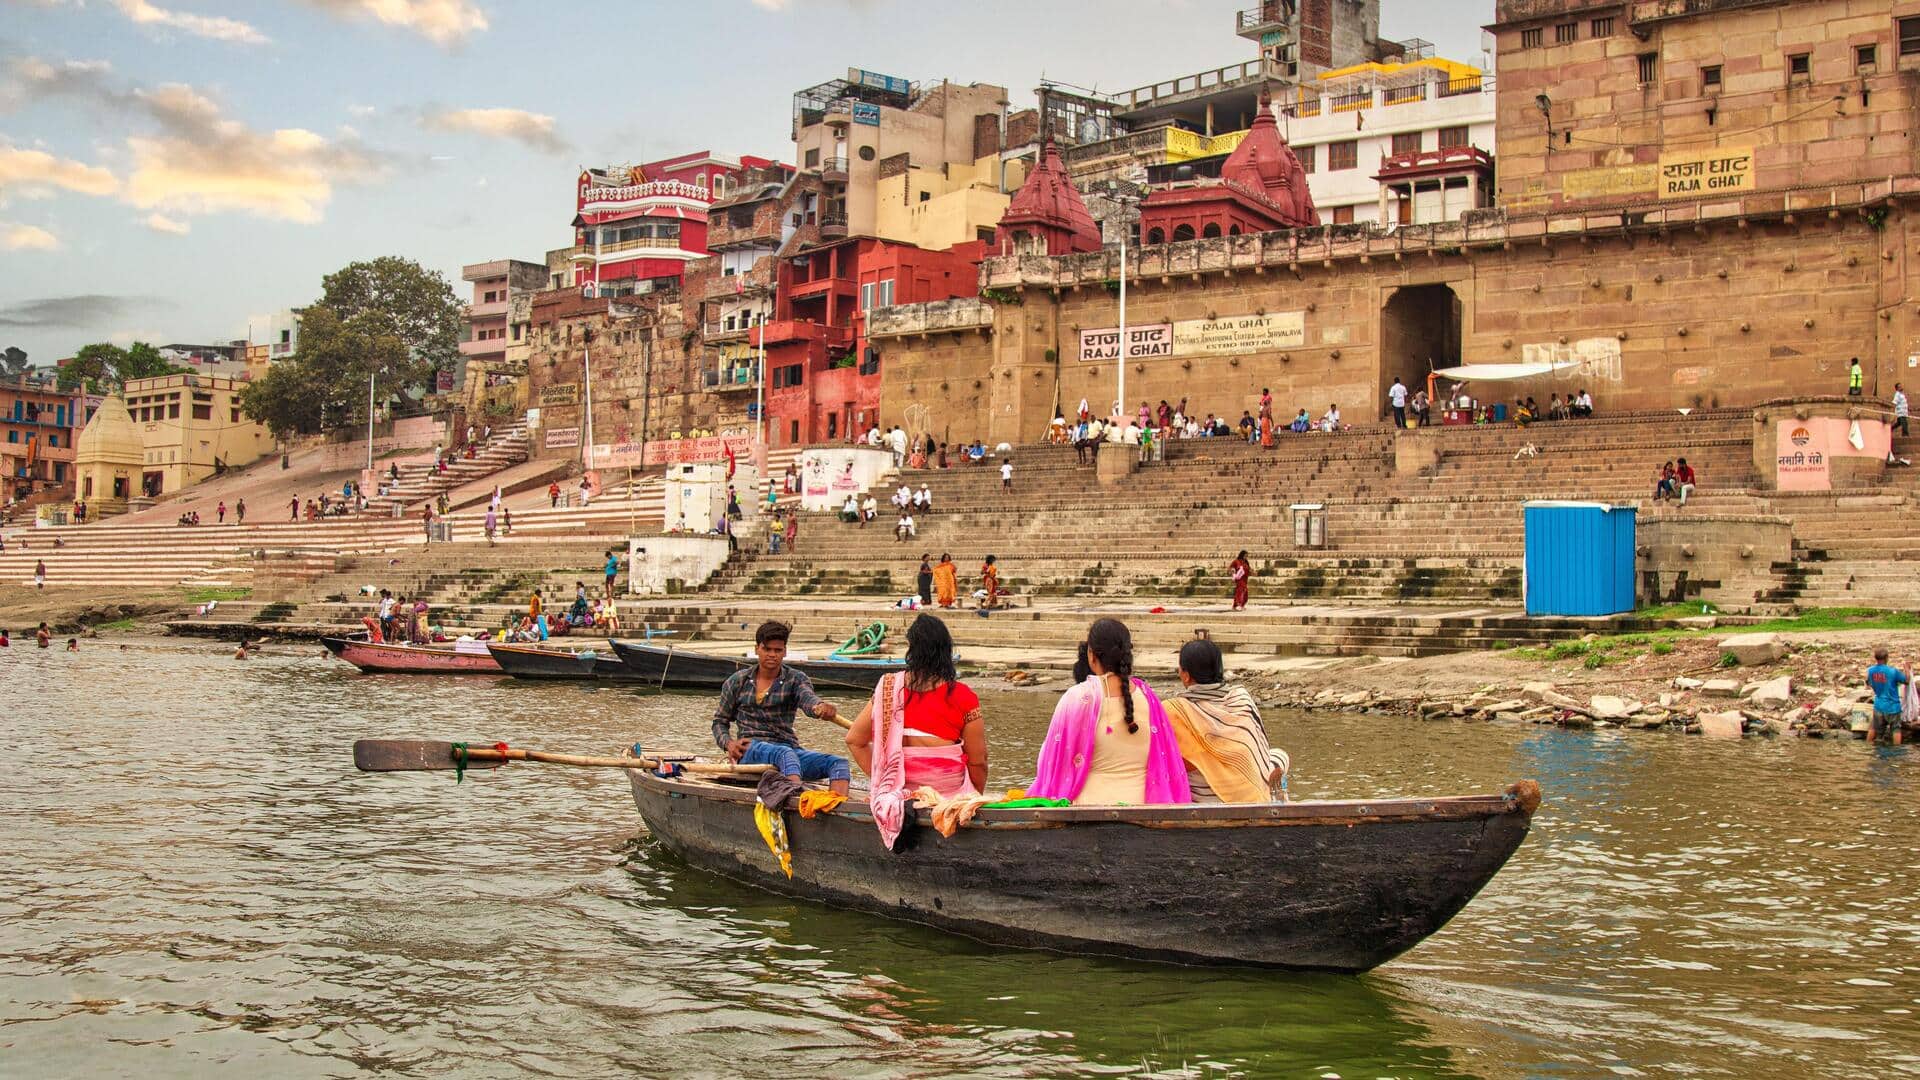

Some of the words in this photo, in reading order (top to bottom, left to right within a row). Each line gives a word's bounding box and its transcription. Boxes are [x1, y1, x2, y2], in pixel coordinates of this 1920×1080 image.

[1663, 161, 1704, 178] राजा
[1709, 156, 1750, 173] घाट
[1668, 179, 1701, 193] RAJA
[1707, 174, 1744, 188] GHAT
[1202, 321, 1234, 331] RAJA
[1239, 318, 1272, 328] GHAT
[1130, 329, 1165, 342] घाट
[1130, 343, 1170, 356] GHAT
[1778, 451, 1805, 466] नमामि
